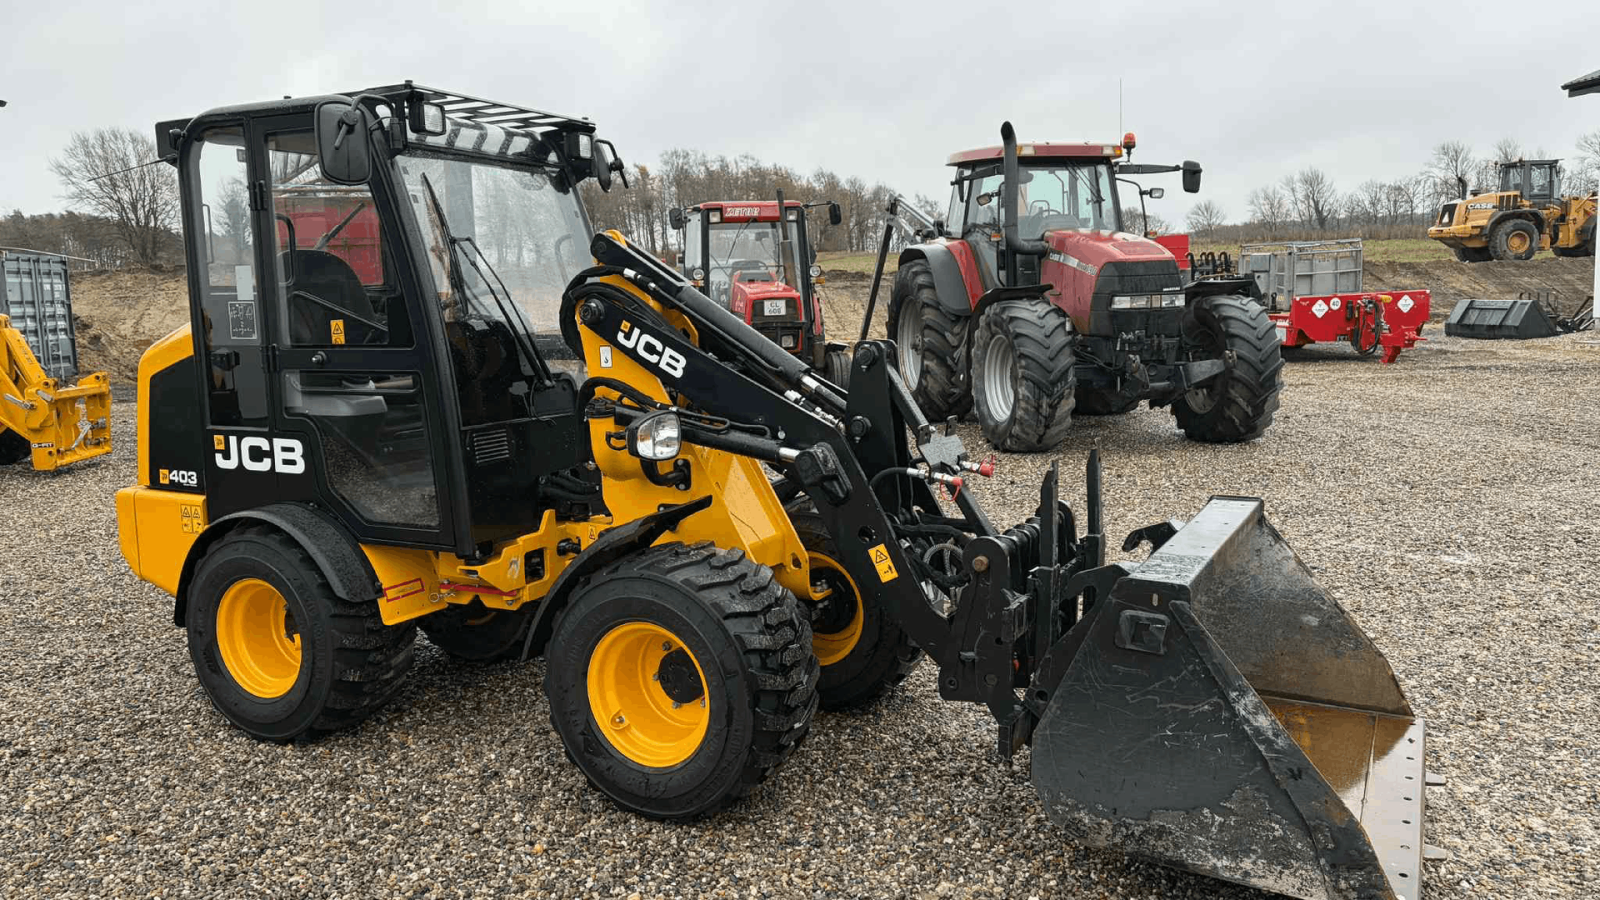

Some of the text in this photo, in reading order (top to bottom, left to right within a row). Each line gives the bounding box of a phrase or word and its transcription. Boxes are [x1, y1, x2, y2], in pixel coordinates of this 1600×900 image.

[617, 327, 687, 378] JCB
[214, 435, 305, 474] JCB
[169, 469, 198, 484] 403
